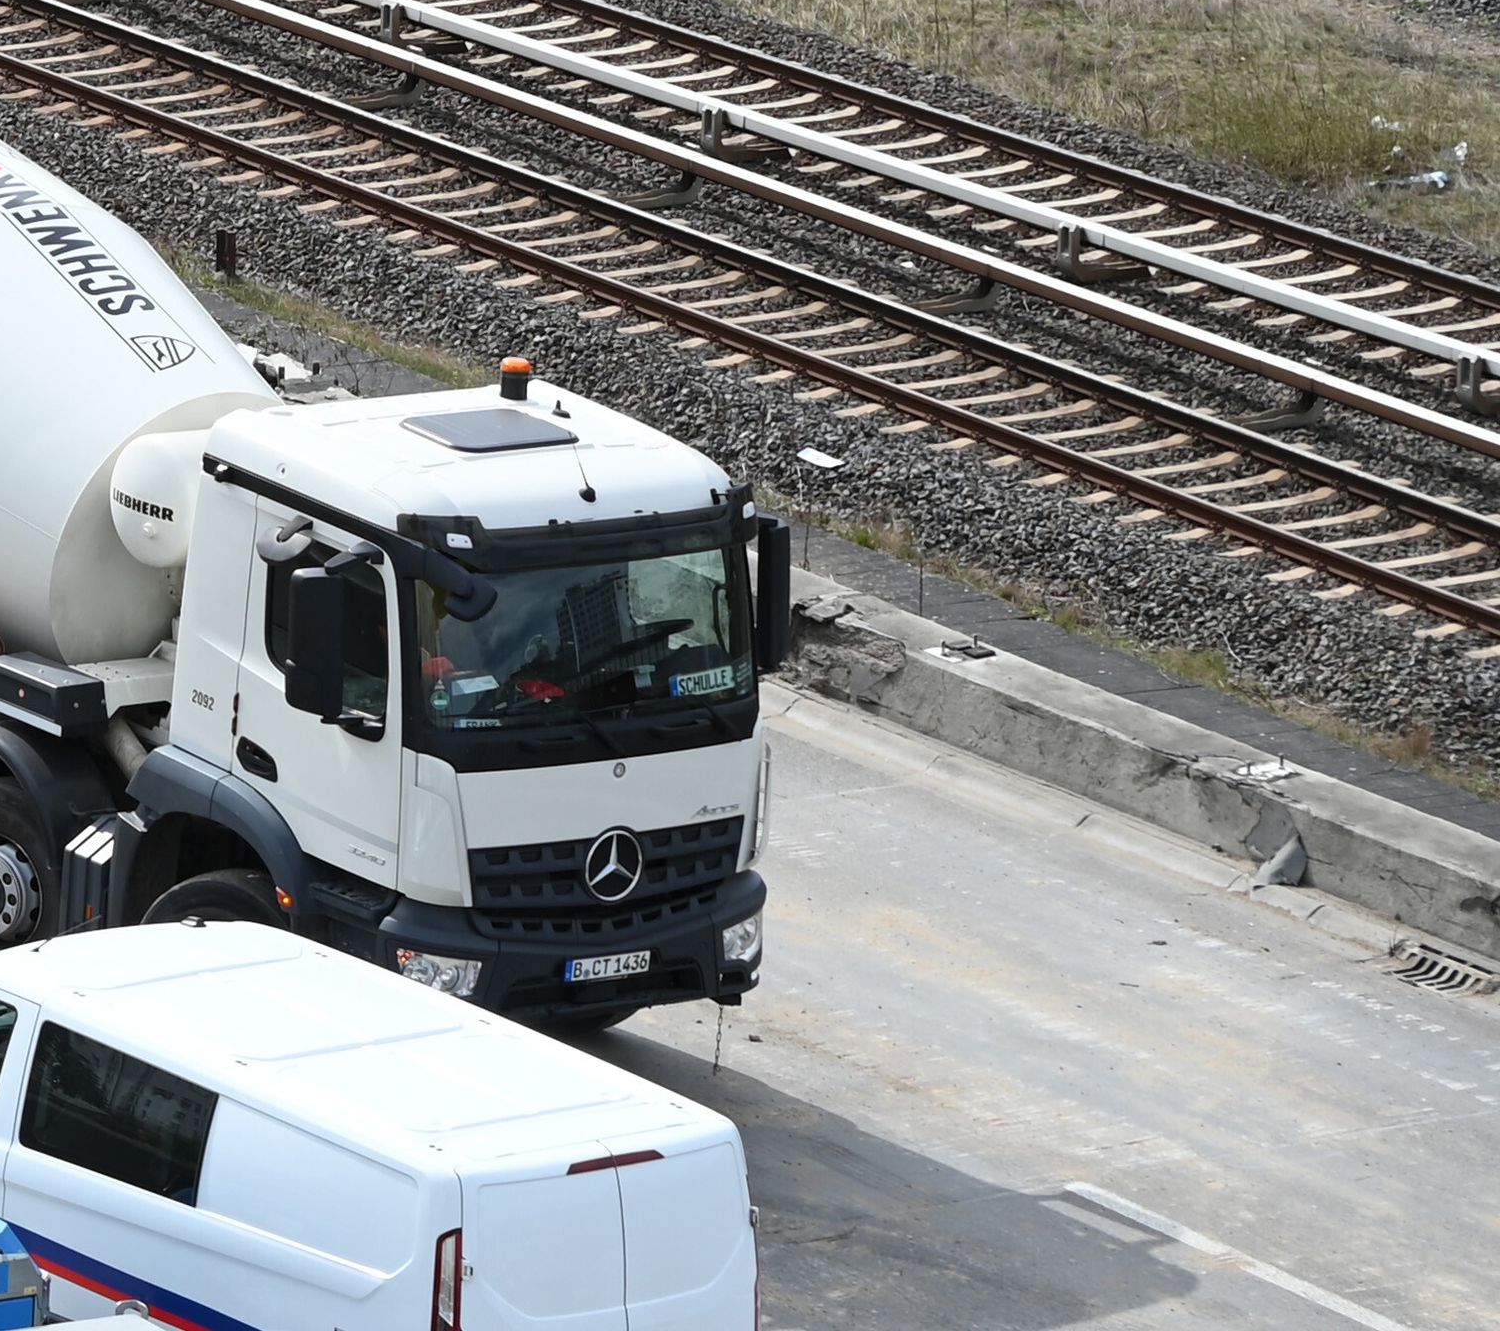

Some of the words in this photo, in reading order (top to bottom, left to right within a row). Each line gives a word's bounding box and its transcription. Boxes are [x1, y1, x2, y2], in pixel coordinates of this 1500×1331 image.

[113, 487, 174, 522] LIEBHERR
[678, 670, 729, 695] SCHULLE
[191, 689, 215, 711] 2092
[573, 962, 583, 979] B
[592, 958, 611, 976] CT
[614, 953, 648, 974] 1436
